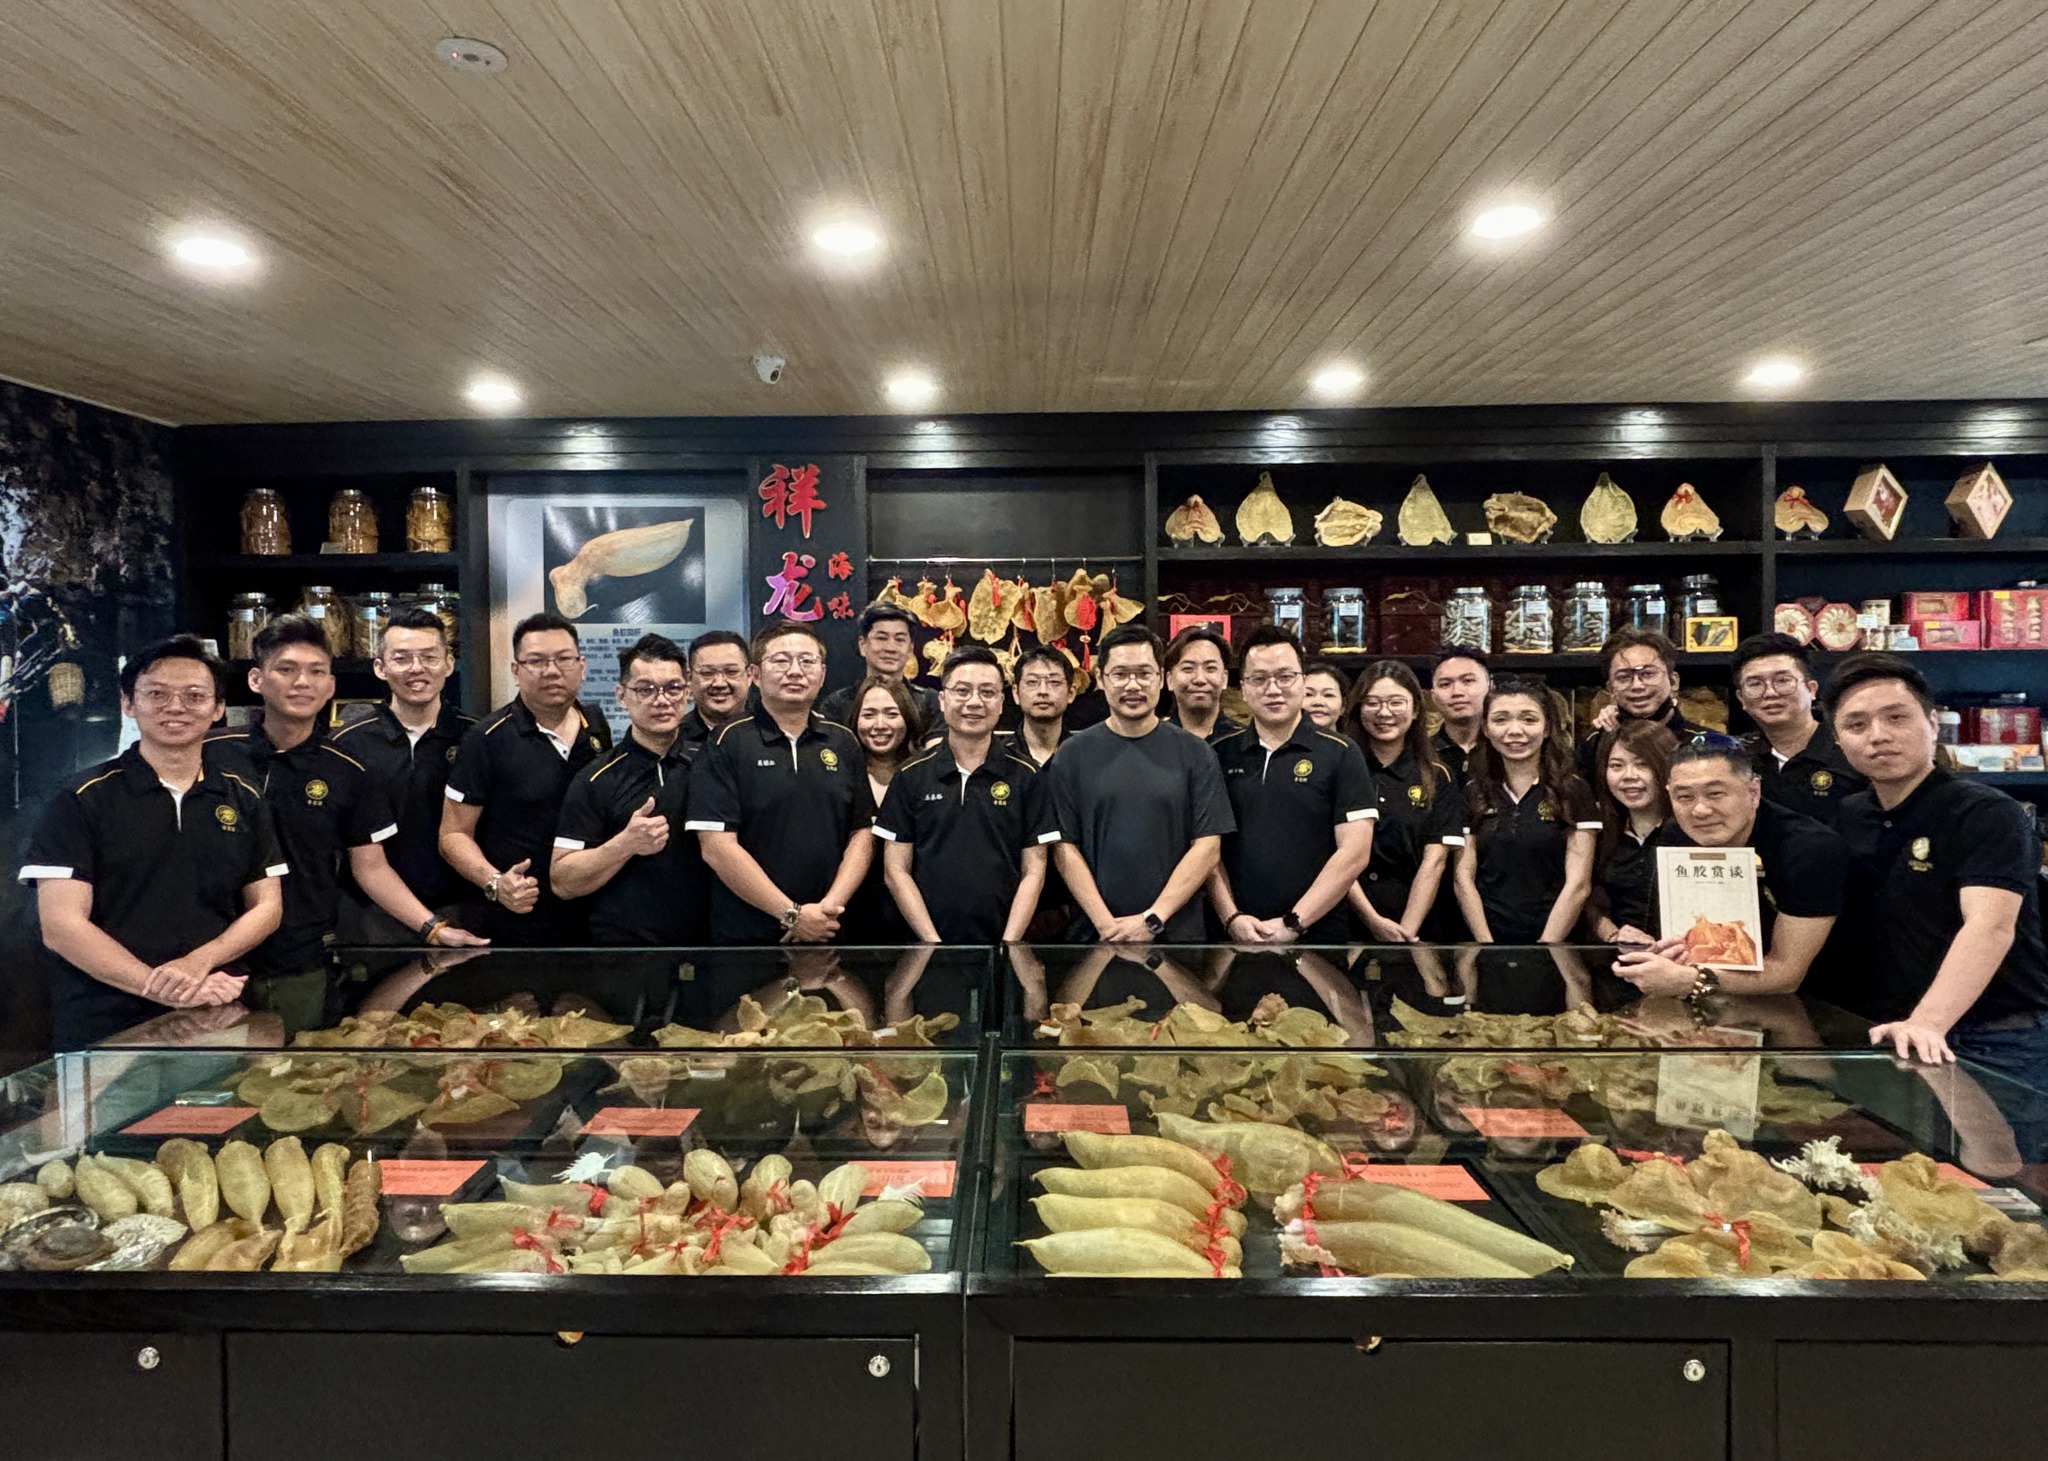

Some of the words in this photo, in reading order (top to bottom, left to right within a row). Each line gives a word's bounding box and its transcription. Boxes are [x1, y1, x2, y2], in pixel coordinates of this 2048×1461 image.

[758, 463, 827, 622] 祥龙
[1674, 864, 1745, 879] 鱼胶赏谈
